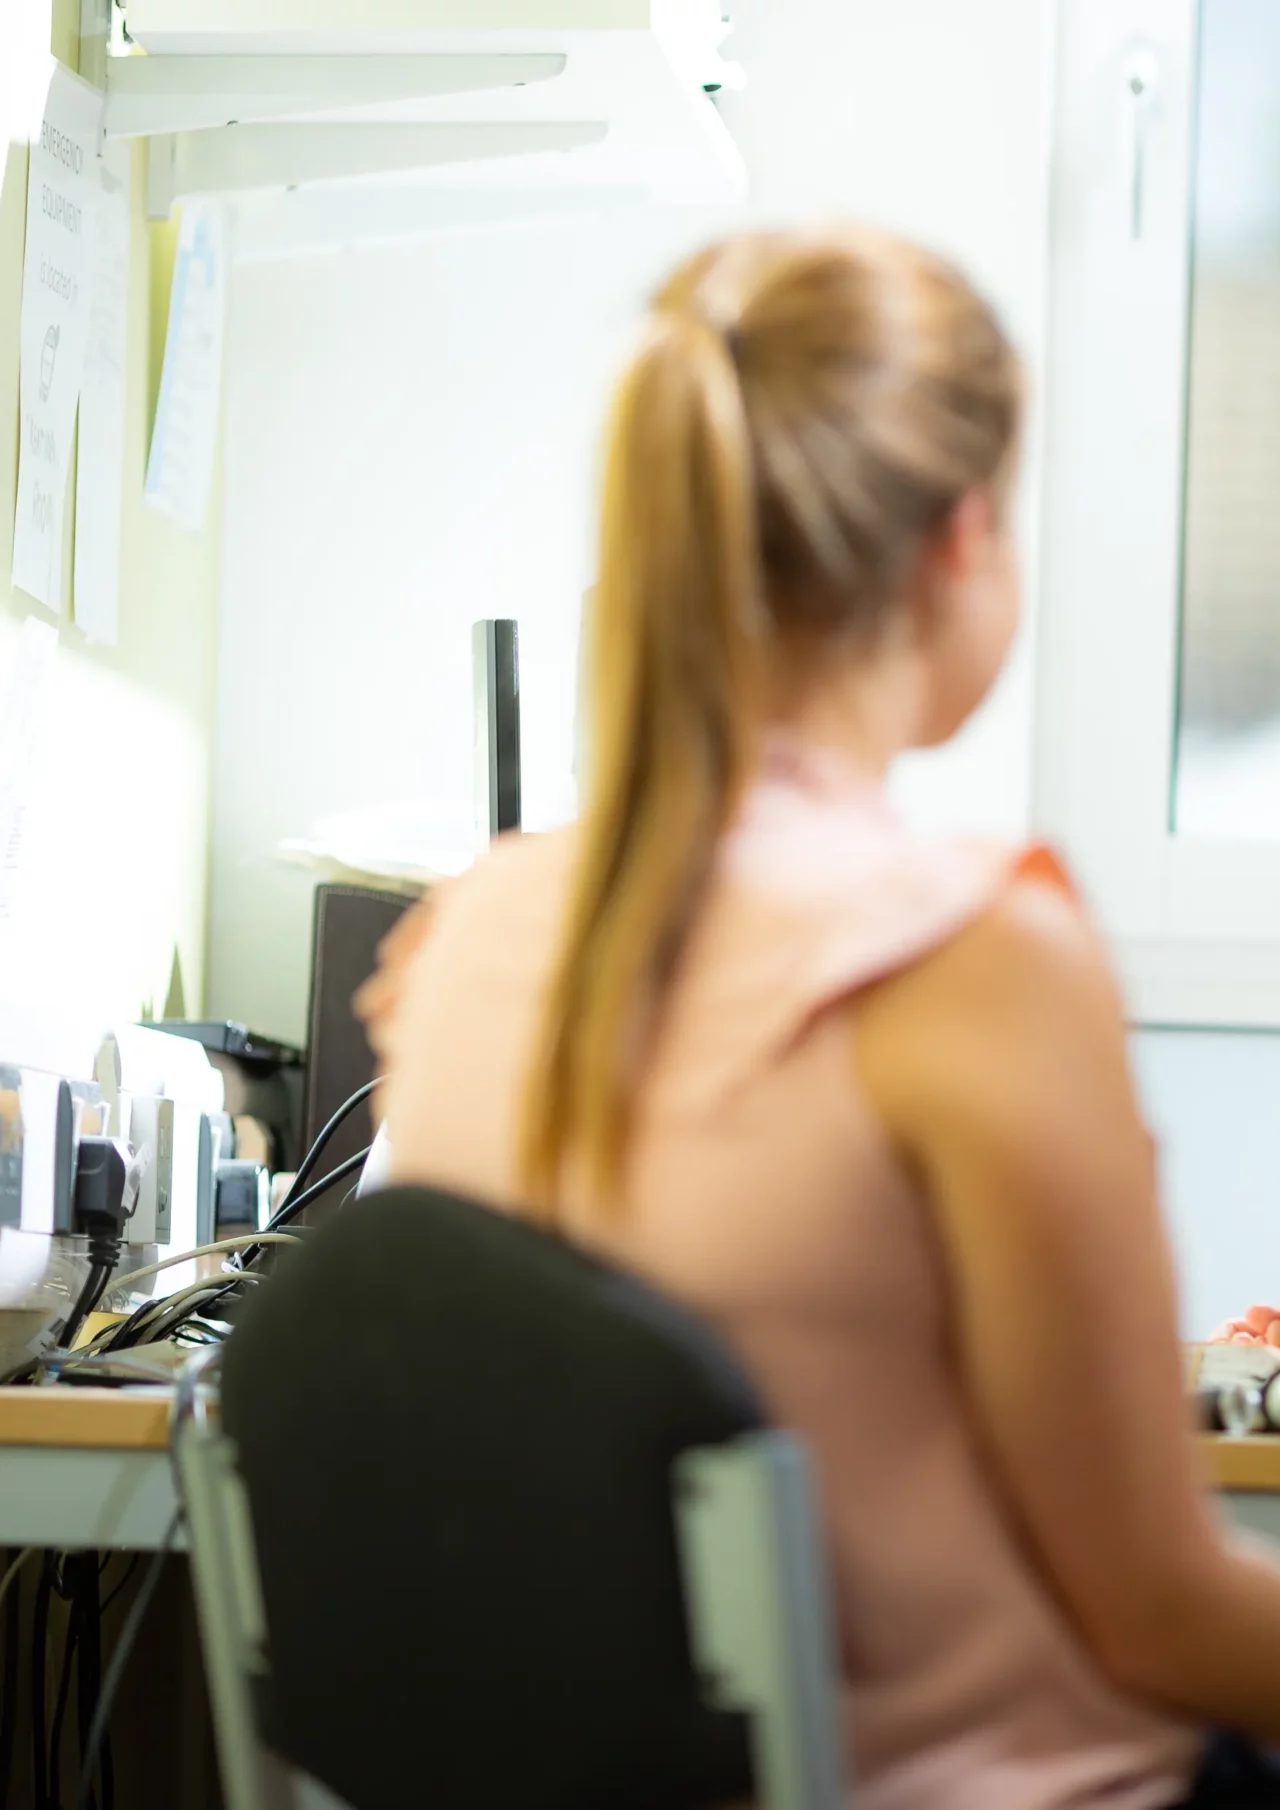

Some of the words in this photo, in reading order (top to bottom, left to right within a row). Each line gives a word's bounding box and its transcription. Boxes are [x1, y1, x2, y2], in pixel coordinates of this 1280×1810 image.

[42, 119, 84, 176] EMERGENCY
[42, 183, 82, 236] EQUIPMENT
[46, 254, 72, 302] located
